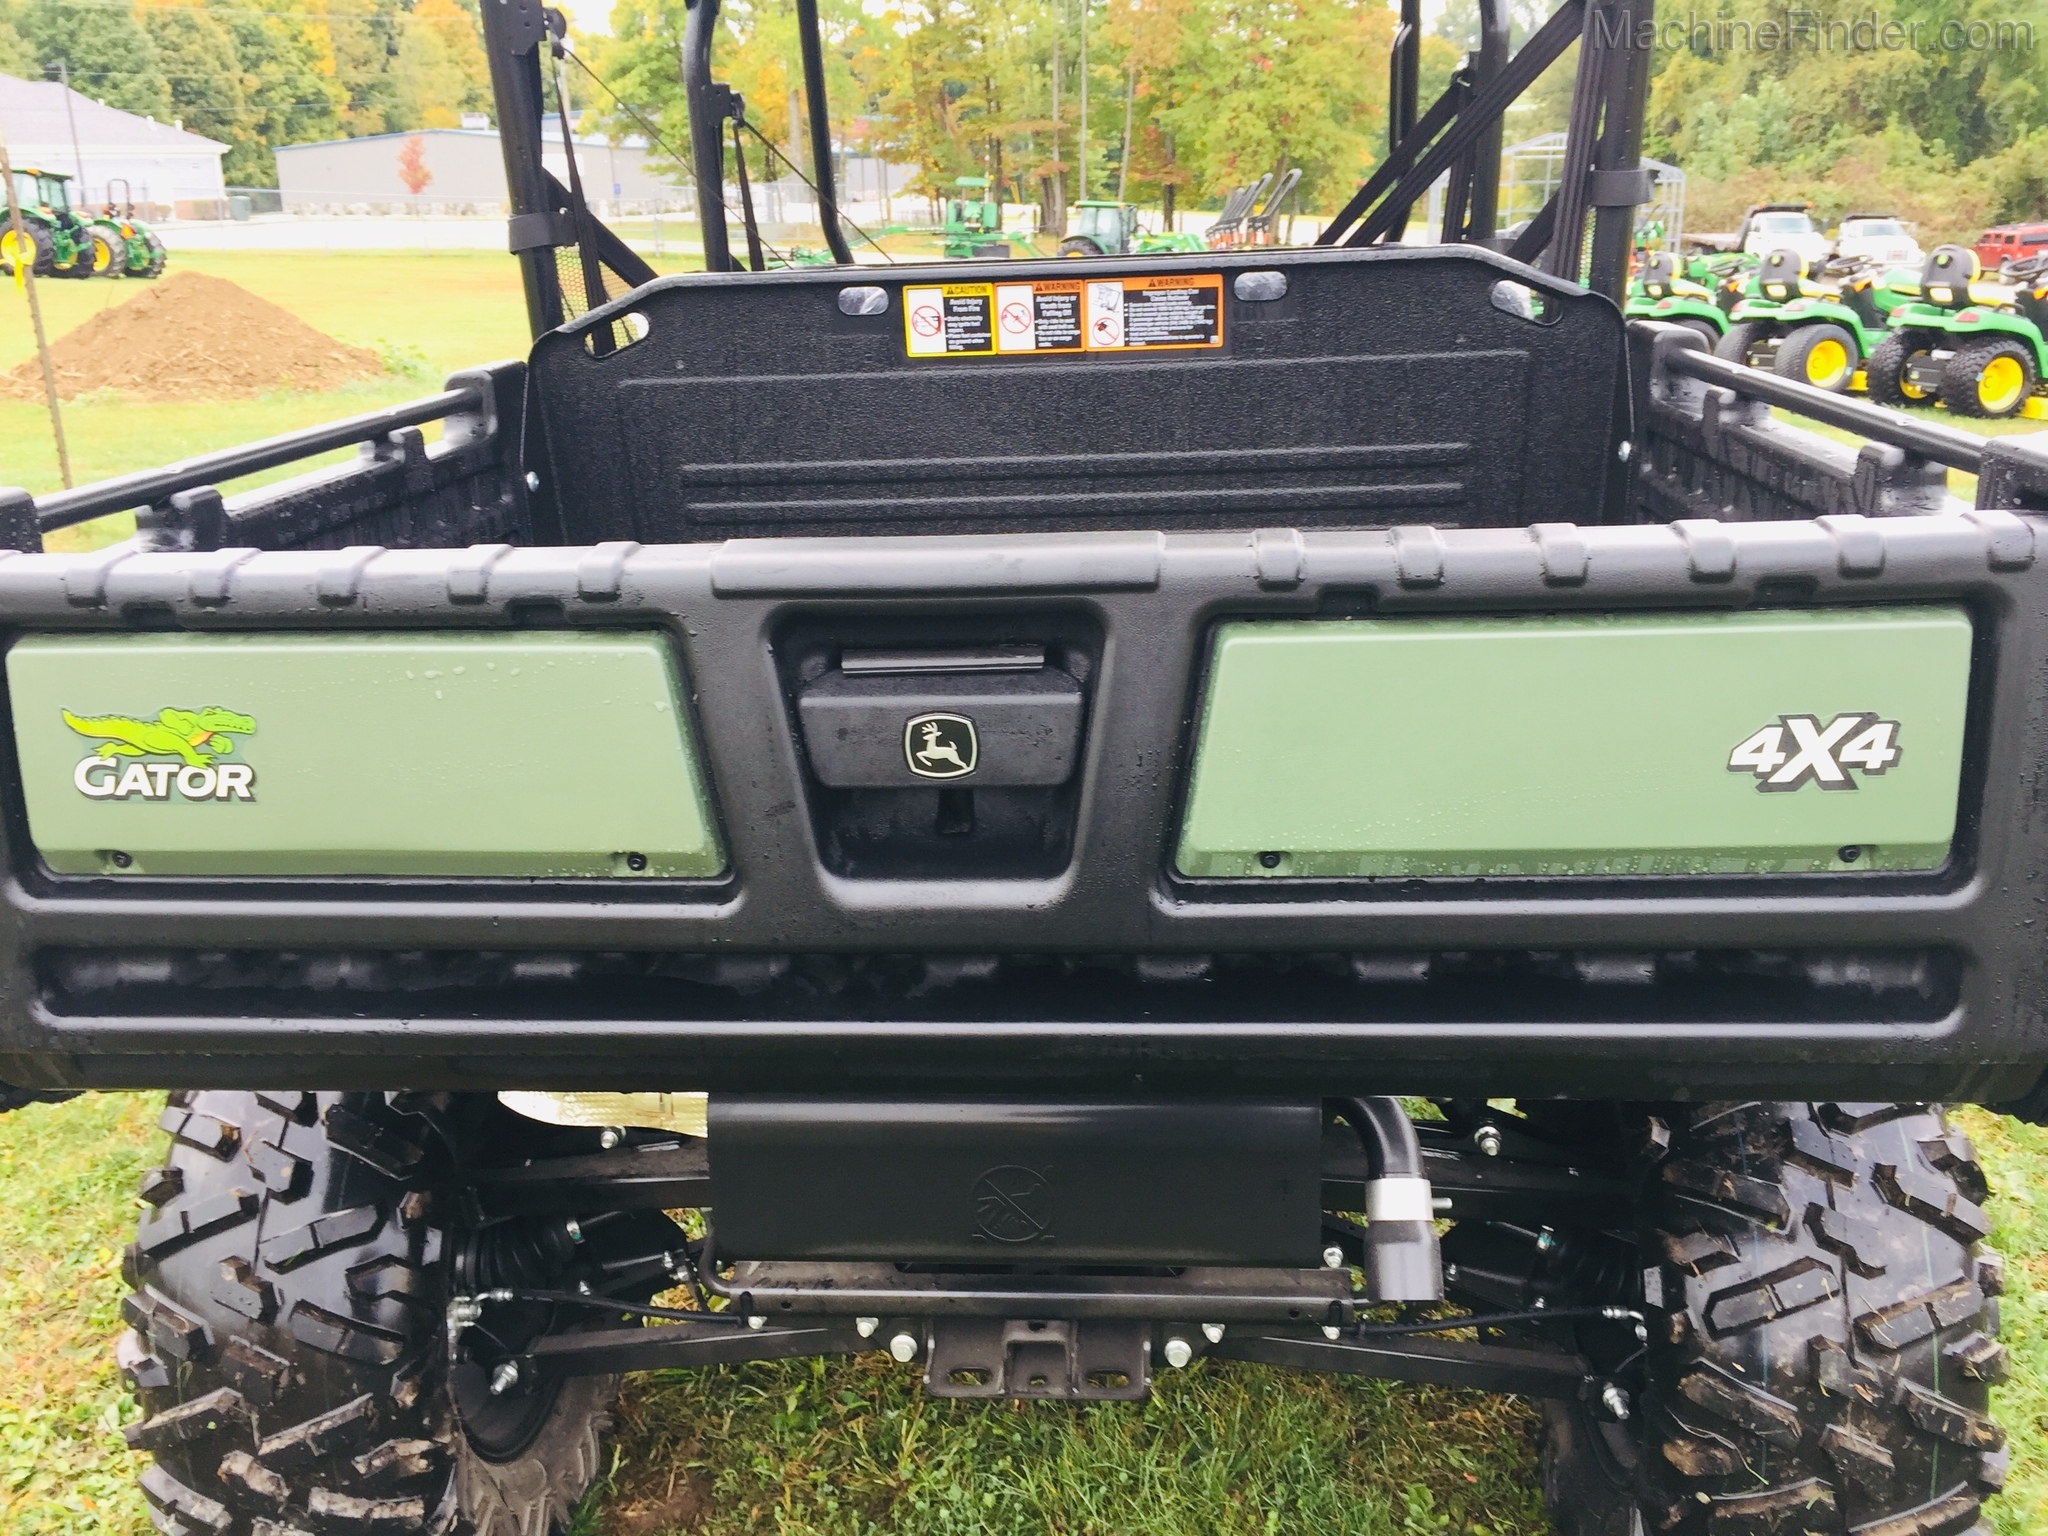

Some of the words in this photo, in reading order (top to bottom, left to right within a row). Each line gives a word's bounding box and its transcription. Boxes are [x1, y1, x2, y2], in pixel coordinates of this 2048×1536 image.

[1044, 282, 1081, 291] WARNING
[1157, 277, 1195, 287] WARNING
[955, 286, 987, 294] CAUTION
[1729, 715, 1899, 787] 4X4
